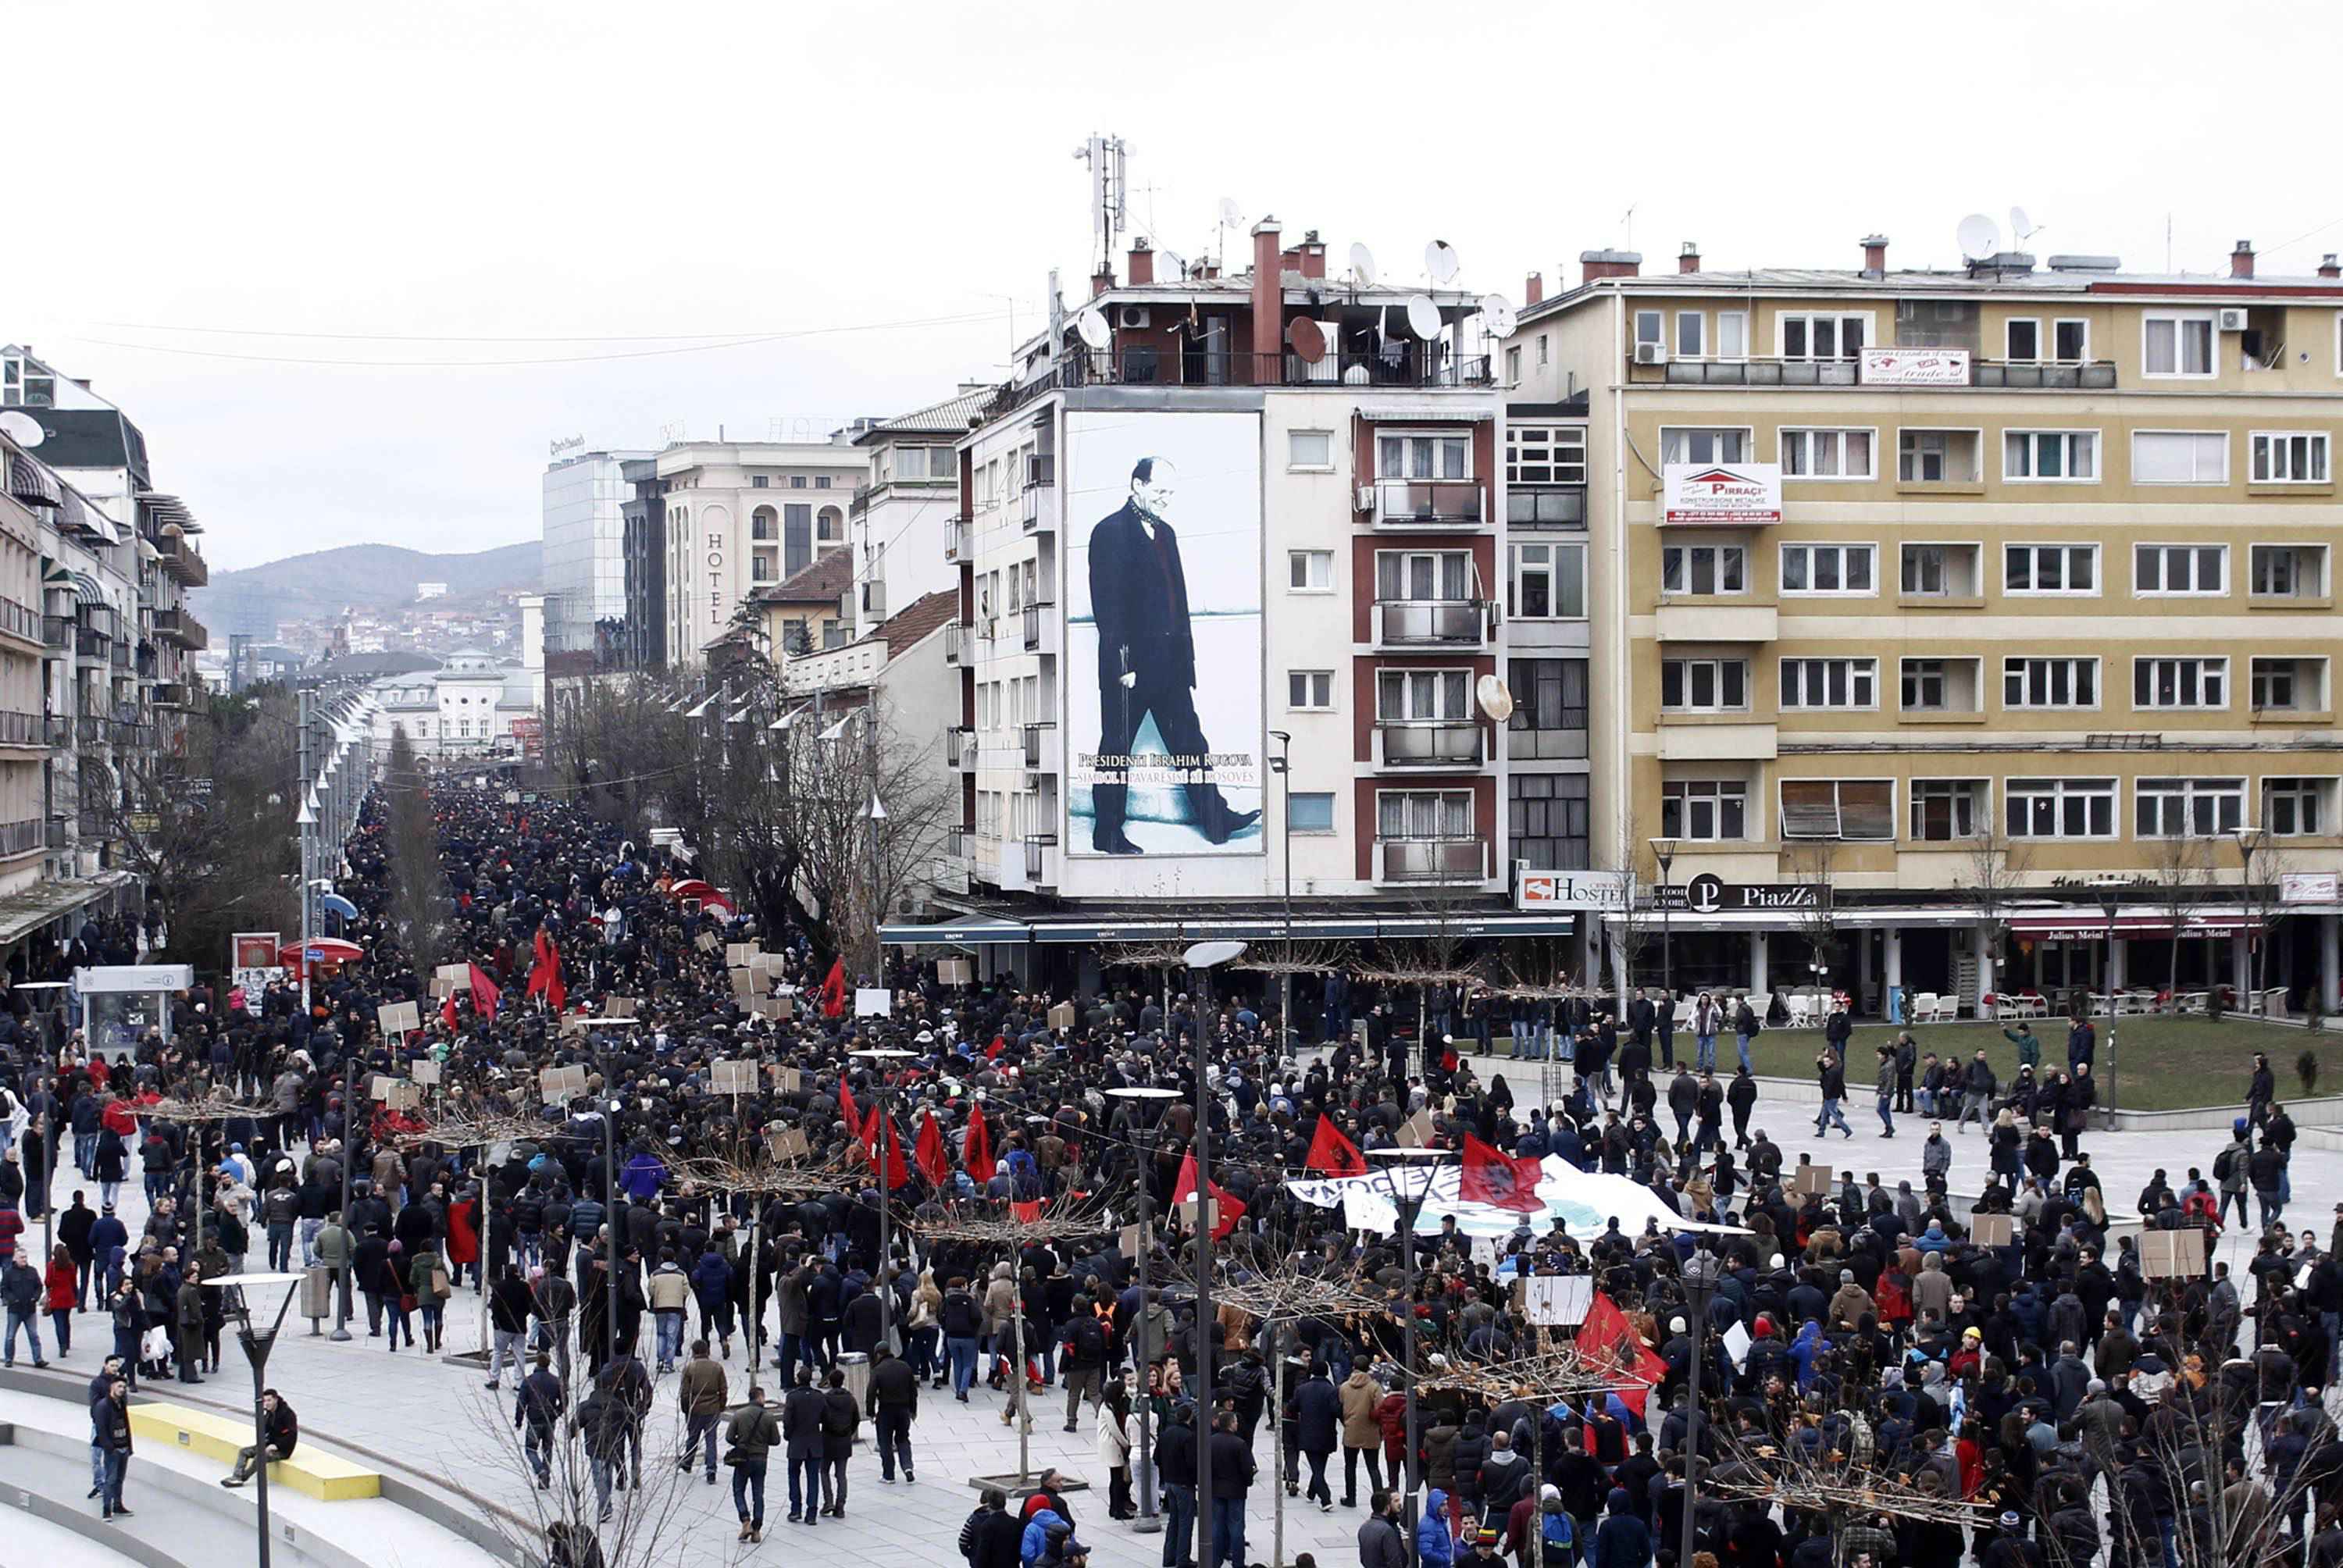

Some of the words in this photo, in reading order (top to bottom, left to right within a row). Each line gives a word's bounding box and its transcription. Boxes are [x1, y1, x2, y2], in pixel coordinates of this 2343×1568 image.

[708, 533, 722, 624] HOTEL
[1078, 754, 1146, 767] PRESIDENTI
[1150, 754, 1200, 767] IBRAHIM
[1204, 754, 1253, 767] RUGOVA
[1078, 772, 1118, 782] SIMBOL
[2048, 931, 2074, 939] Julius
[2078, 931, 2103, 939] Meinl
[2206, 928, 2231, 937] Meinl
